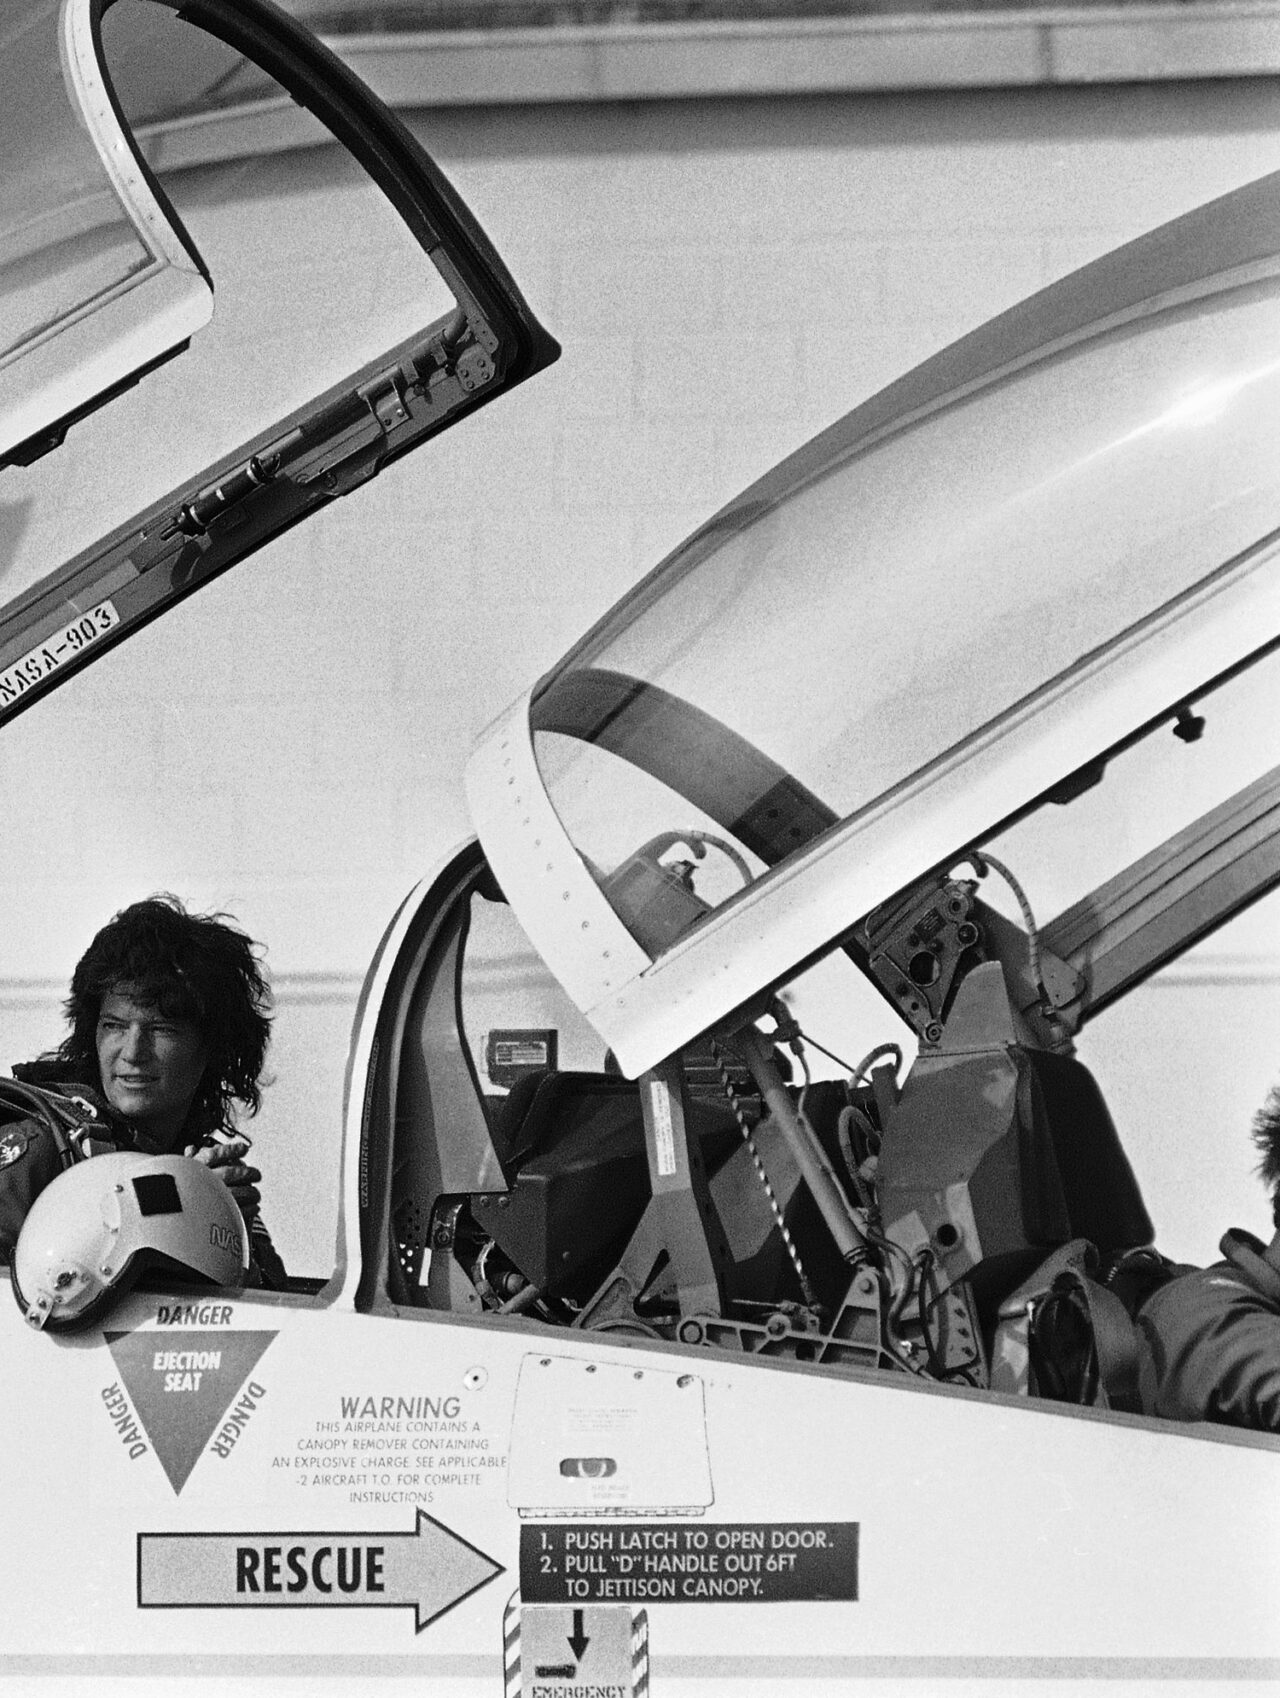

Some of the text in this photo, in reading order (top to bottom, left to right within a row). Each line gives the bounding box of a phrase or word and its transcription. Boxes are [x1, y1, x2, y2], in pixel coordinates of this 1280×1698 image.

[210, 1223, 242, 1257] NAS
[157, 1305, 234, 1326] DANGER
[153, 1351, 222, 1371] EJECTION
[164, 1372, 202, 1392] SEAT
[341, 1396, 461, 1419] WARNING
[101, 1381, 148, 1460] DANGER
[210, 1381, 267, 1459] DANGER
[316, 1421, 481, 1433] THIS AIRPLANE CONTAINS A
[297, 1439, 489, 1450] CANOPY REMOVER CONTAINING
[272, 1456, 290, 1468] AN
[295, 1456, 357, 1468] EXPLOSIVE
[416, 1456, 435, 1468] SEE
[439, 1456, 507, 1468] APPLICABLE
[313, 1474, 367, 1486] AIRCRAFT
[397, 1474, 420, 1486] FOR
[424, 1473, 481, 1485] COMPLETE
[349, 1491, 434, 1503] INSTRUCTIONS
[540, 1531, 834, 1550] 1. PUSH LATCH TO OPEN DOOR.
[236, 1546, 385, 1593] RESCUE
[540, 1555, 558, 1573] 2.
[565, 1555, 606, 1573] PULL
[645, 1555, 718, 1573] HANDLE
[725, 1554, 764, 1572] OUT
[565, 1578, 764, 1596] TO JETTISON CANOPY.
